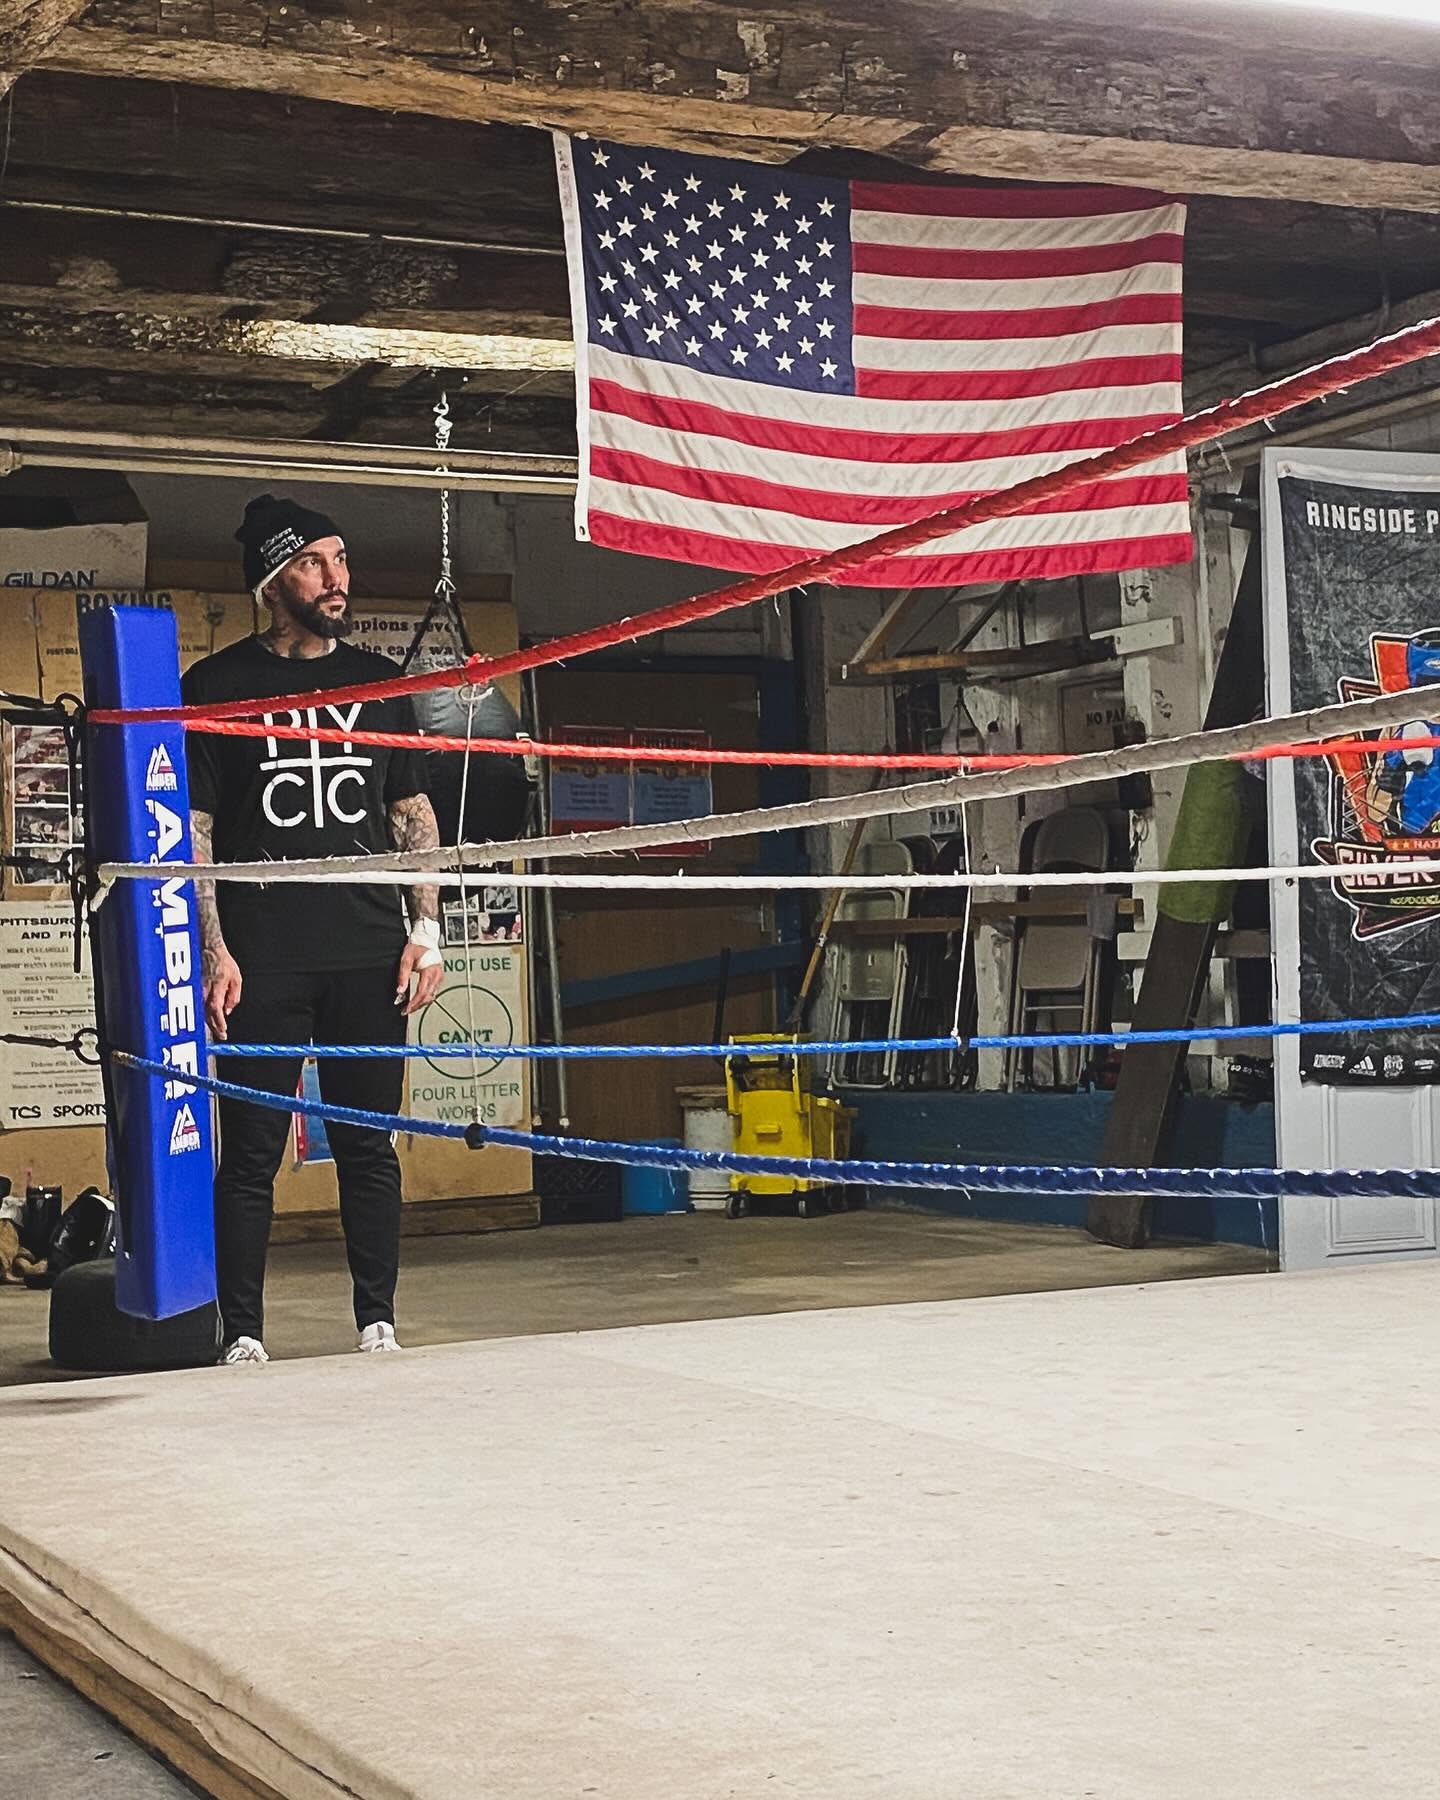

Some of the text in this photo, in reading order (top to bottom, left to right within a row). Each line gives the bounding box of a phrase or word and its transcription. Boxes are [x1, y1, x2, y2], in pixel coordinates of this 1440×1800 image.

[1306, 501, 1416, 533] RINGSIDE
[4, 569, 95, 588] GILDAN
[21, 931, 51, 939] AND
[443, 957, 512, 972] NOT USE
[438, 1029, 493, 1045] CAN'T
[412, 1082, 520, 1102] FOUR LETTER
[9, 1105, 41, 1119] TCS
